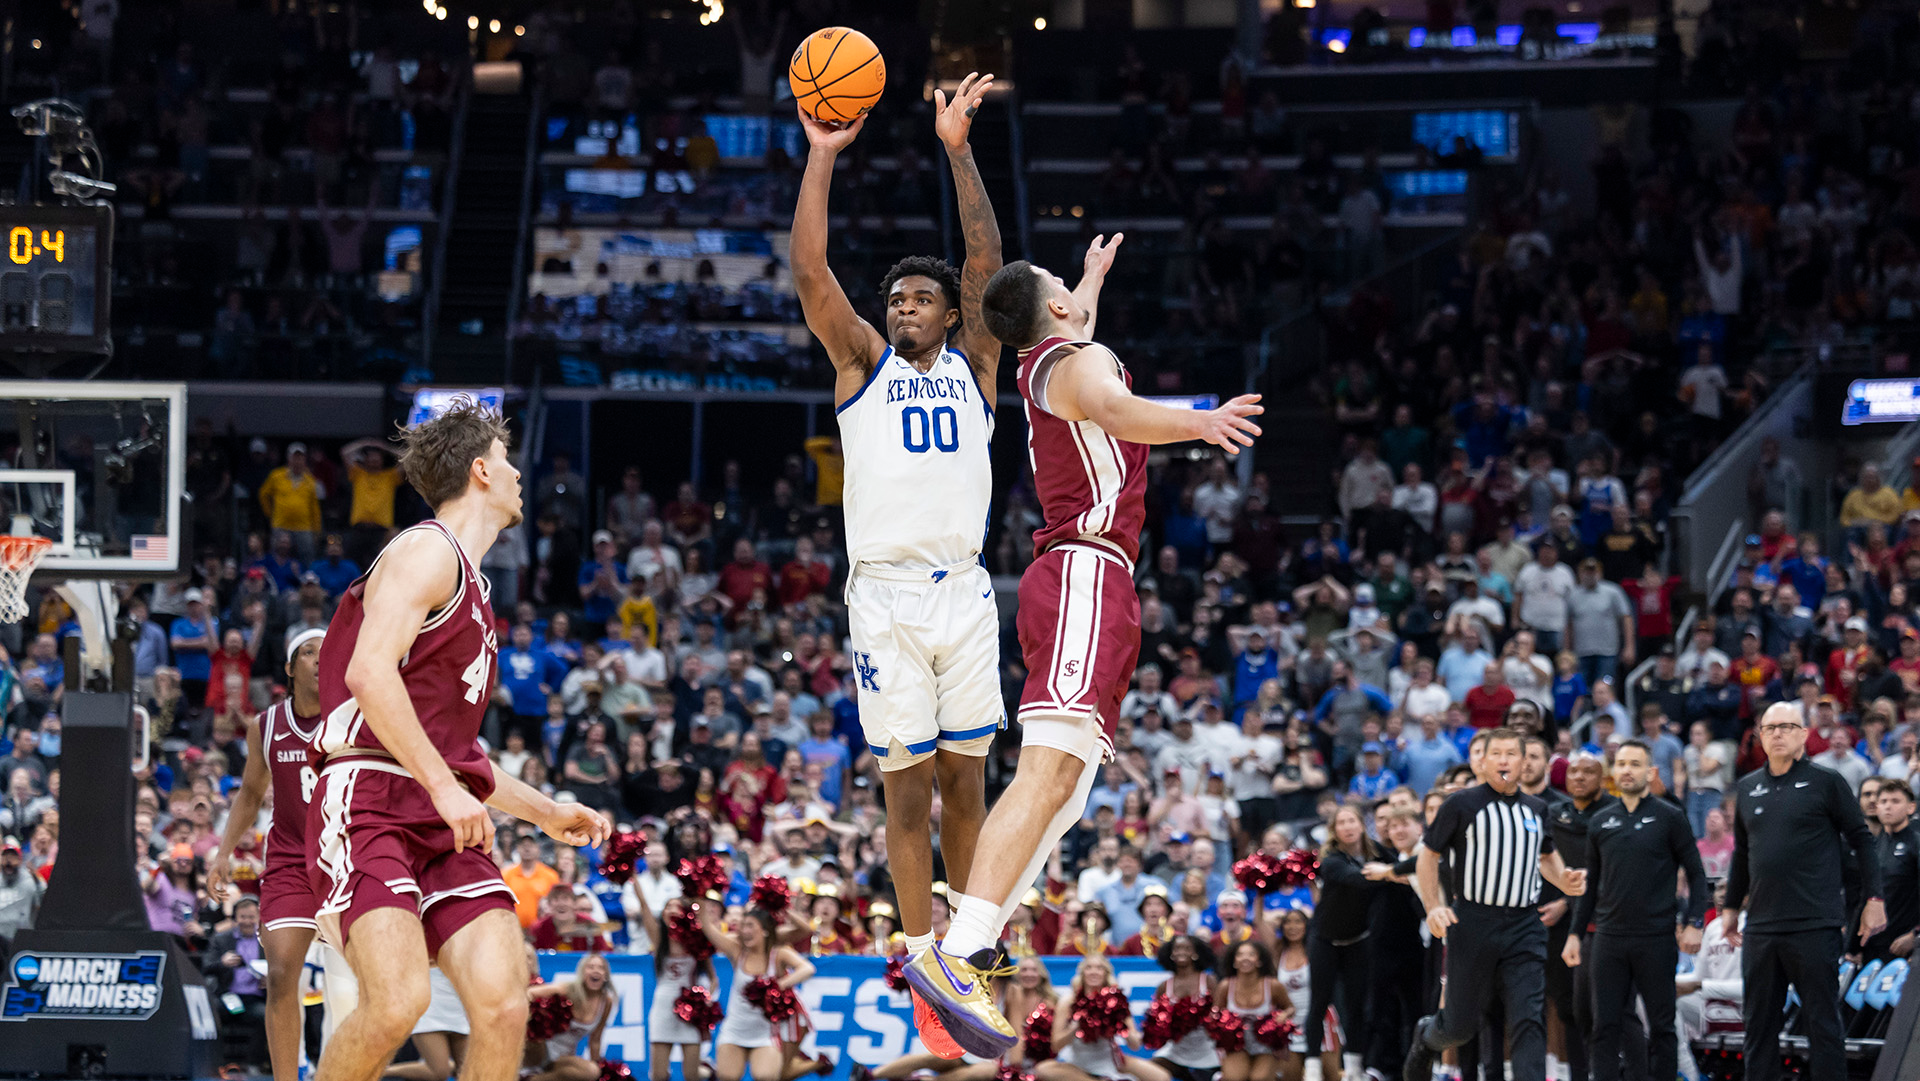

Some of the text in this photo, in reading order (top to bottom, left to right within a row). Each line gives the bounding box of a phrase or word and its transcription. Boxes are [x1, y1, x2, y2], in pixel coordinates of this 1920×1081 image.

[9, 226, 65, 264] 0.4
[886, 376, 968, 404] KENTUCKY
[902, 406, 960, 453] 00
[276, 749, 308, 763] SANTA
[300, 765, 319, 804] 8
[38, 958, 122, 984] MARCH
[46, 983, 159, 1010] MADNESS
